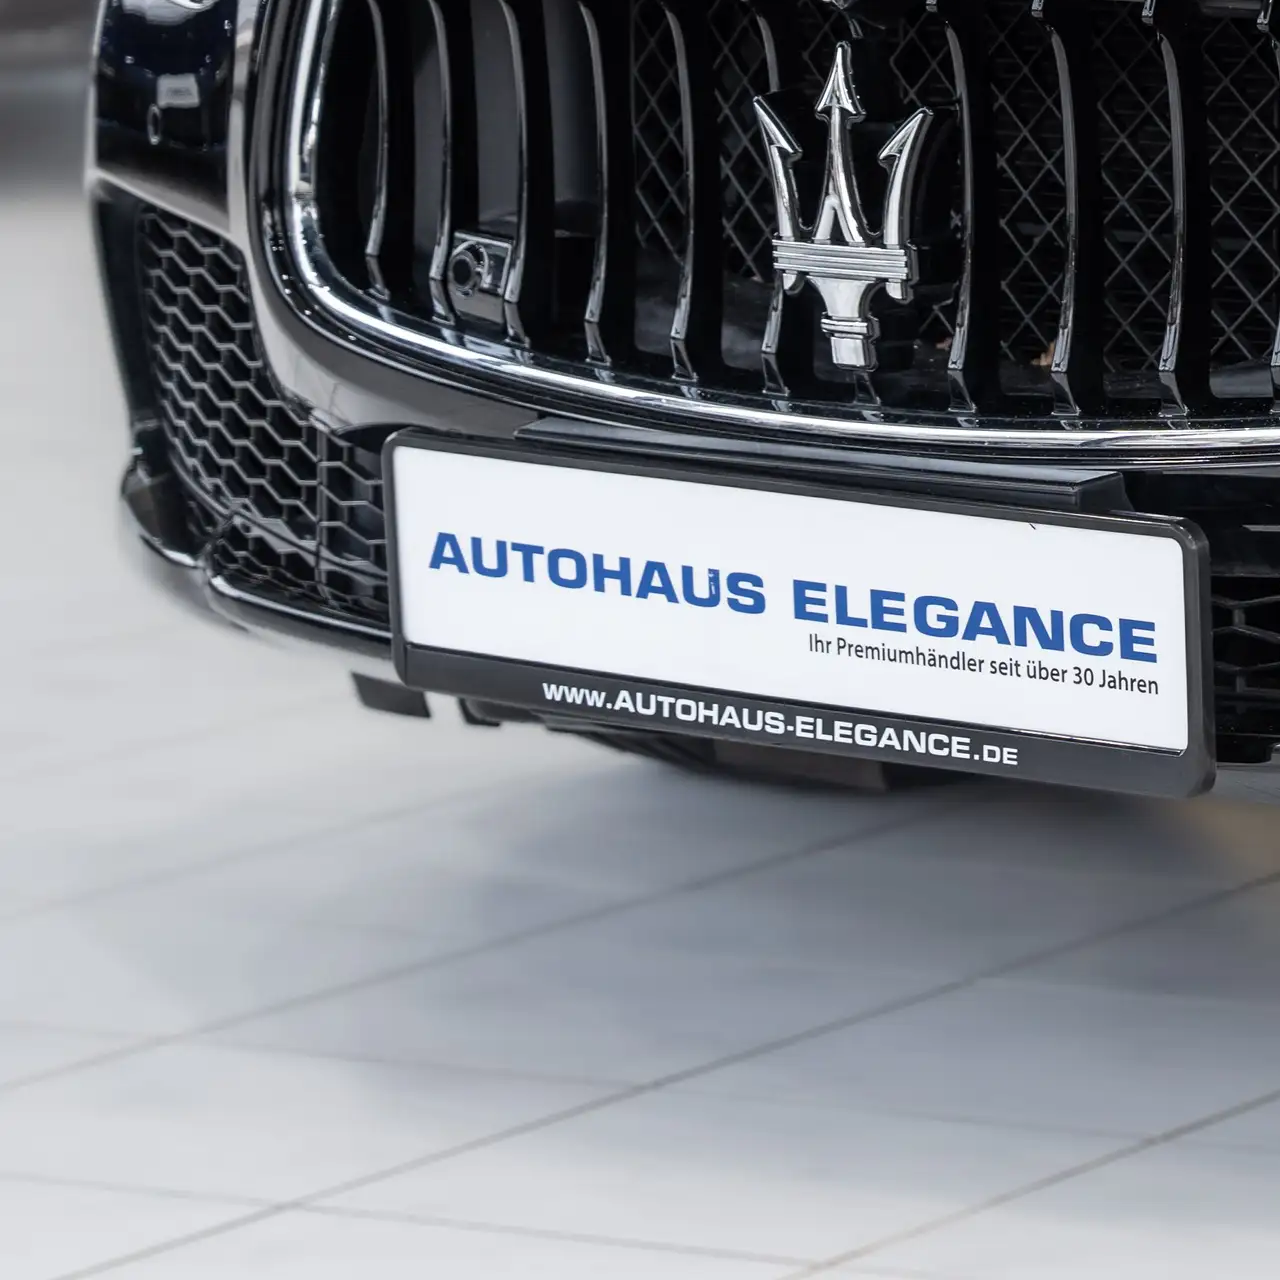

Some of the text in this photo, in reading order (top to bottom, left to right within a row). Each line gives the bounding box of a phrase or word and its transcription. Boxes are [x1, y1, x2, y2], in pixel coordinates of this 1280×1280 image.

[429, 532, 1158, 664] AUTOHAUS ELEGANCE
[809, 633, 1159, 695] Ihr Premiumhändler seit über 30 Jahren
